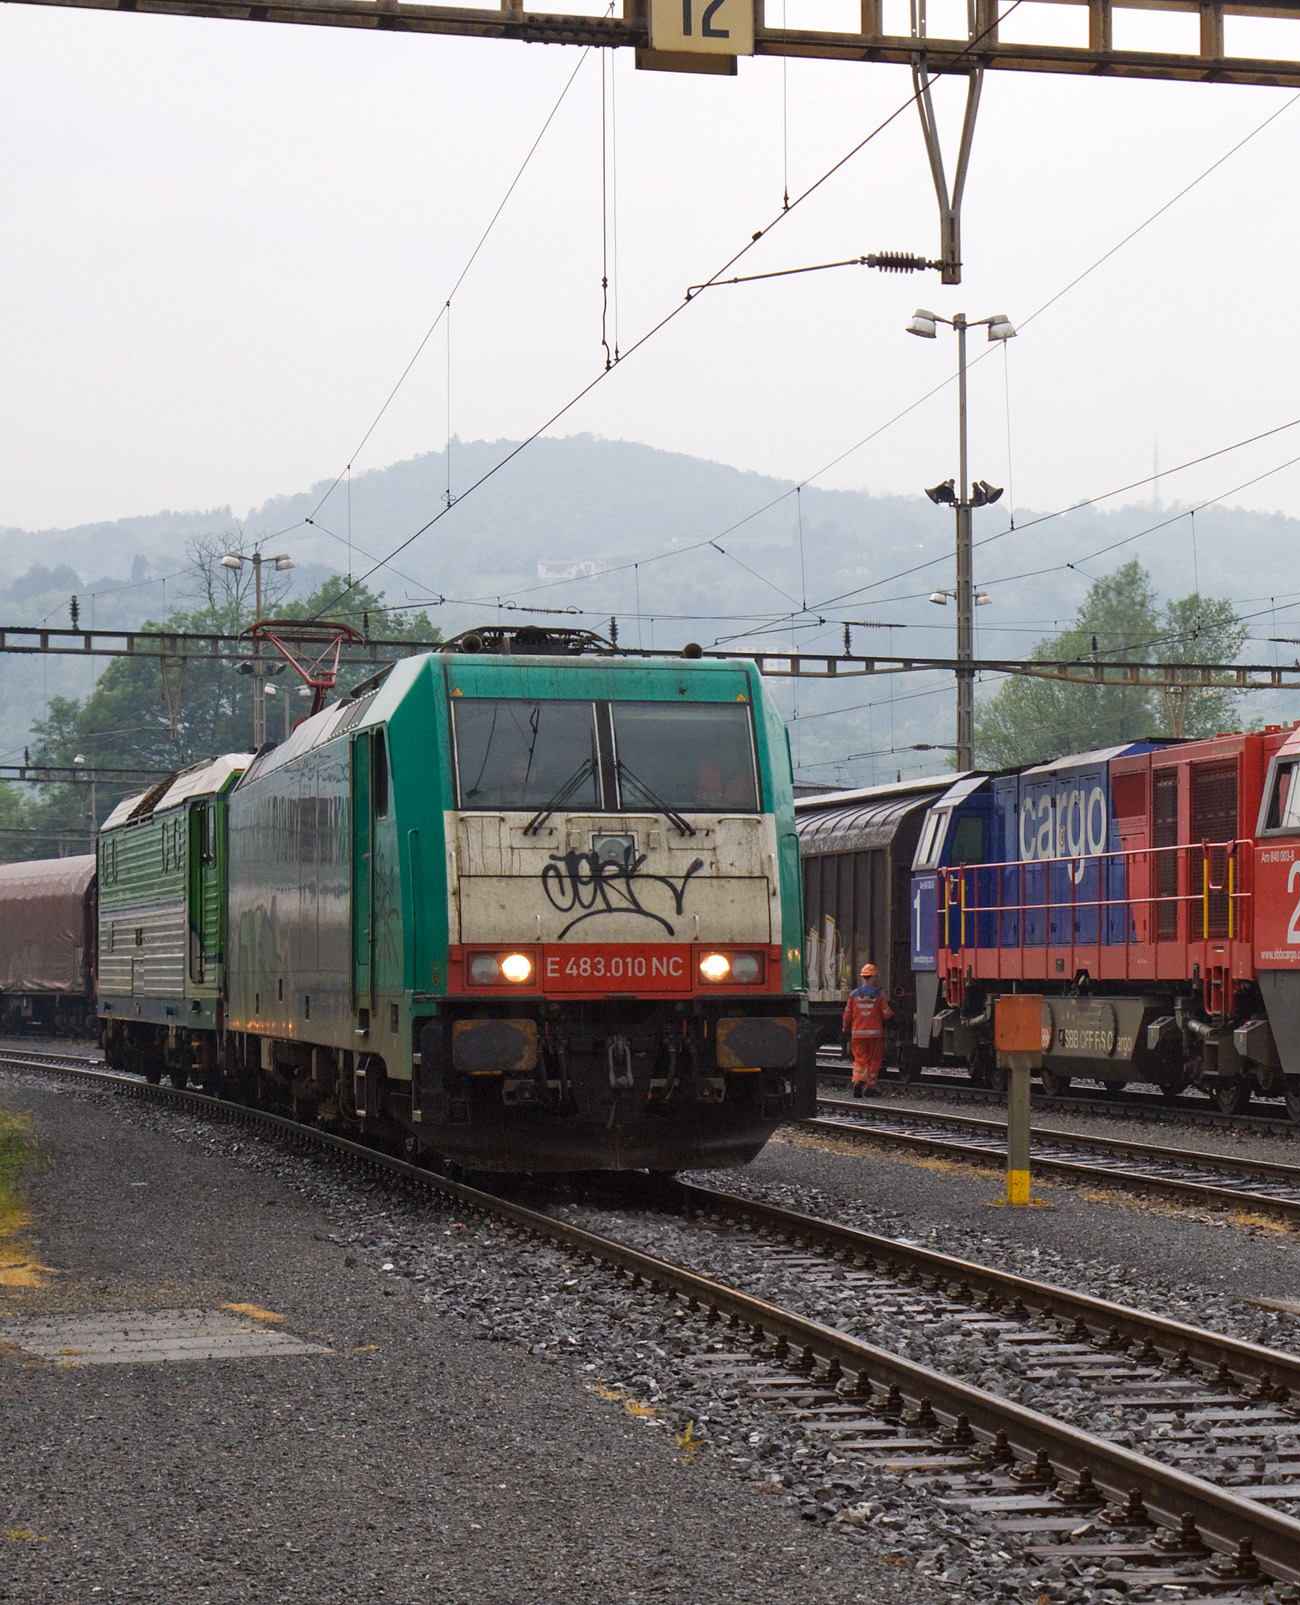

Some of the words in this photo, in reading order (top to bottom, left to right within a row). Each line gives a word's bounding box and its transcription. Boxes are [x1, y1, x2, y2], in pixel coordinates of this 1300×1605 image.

[1020, 787, 1107, 885] cargo
[913, 889, 921, 952] 1
[547, 957, 560, 977] E
[565, 957, 646, 977] 483.010
[652, 957, 683, 977] NC
[1064, 1029, 1079, 1049] SBB
